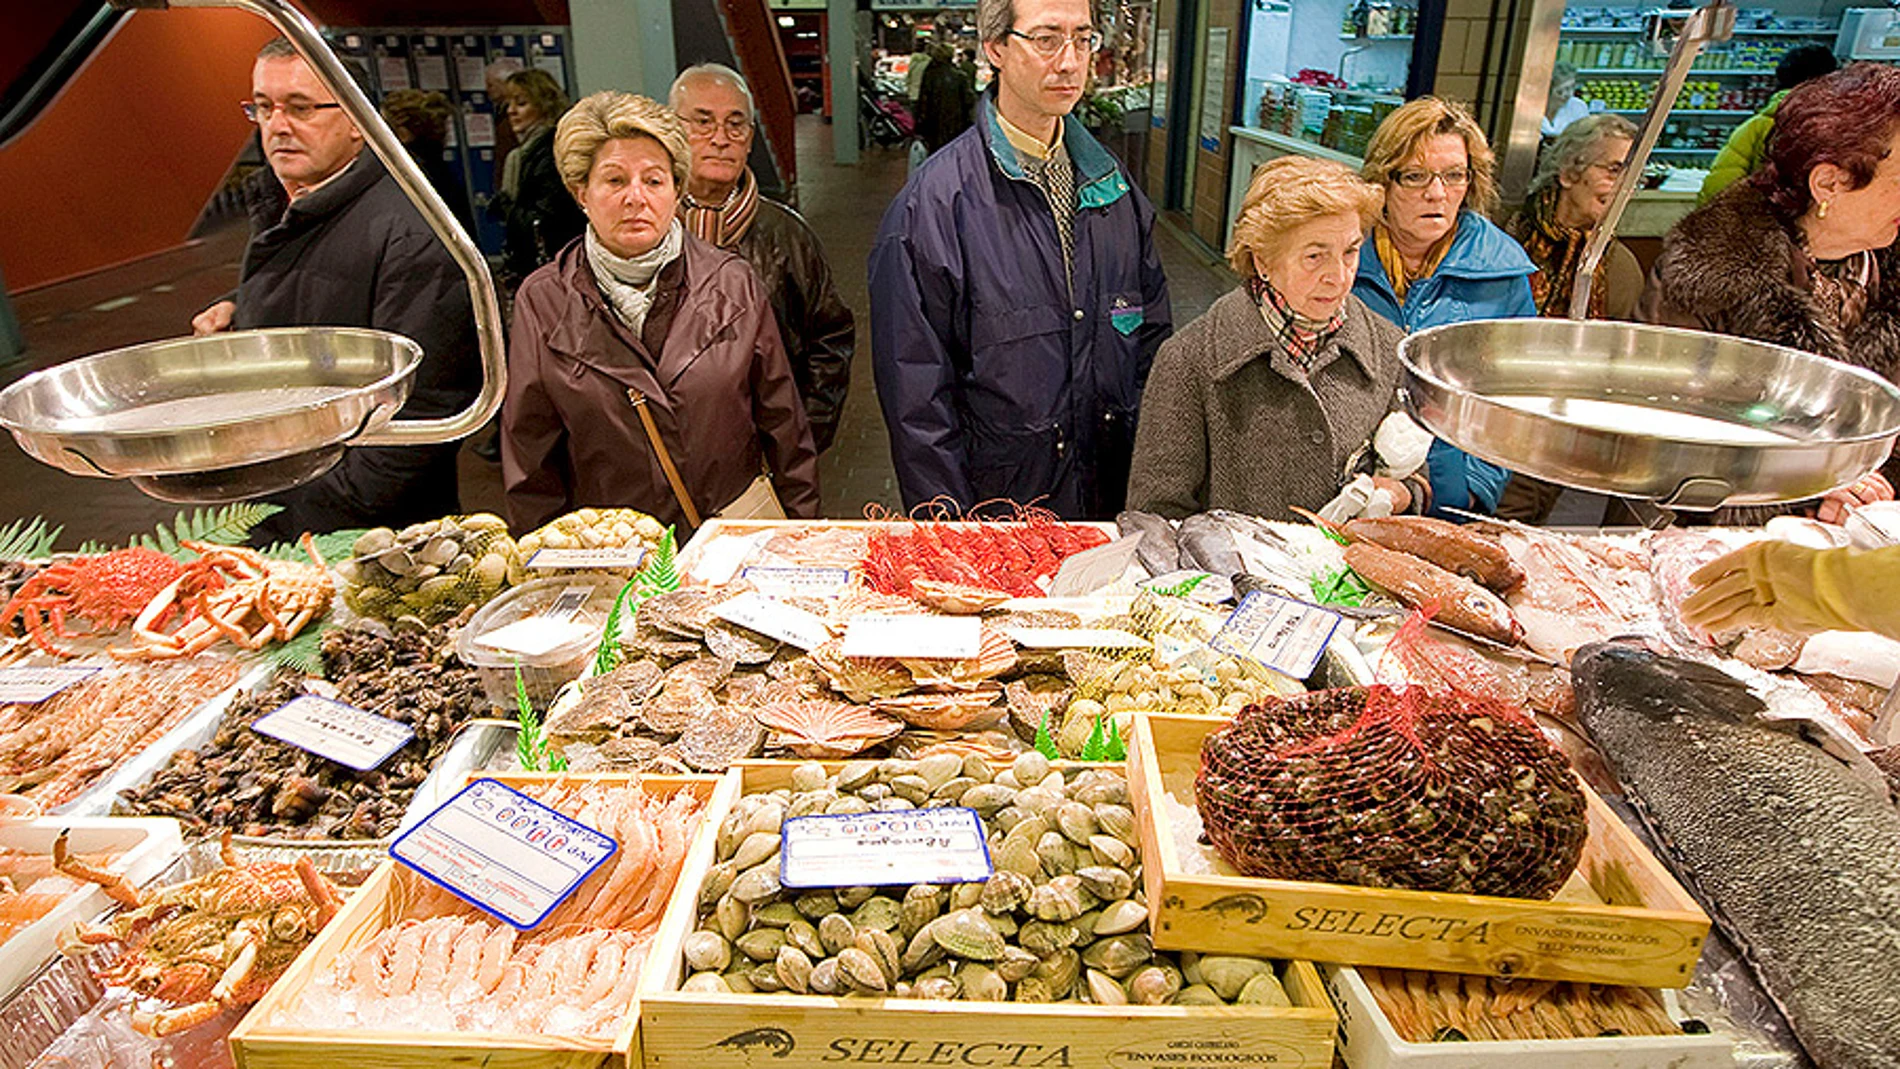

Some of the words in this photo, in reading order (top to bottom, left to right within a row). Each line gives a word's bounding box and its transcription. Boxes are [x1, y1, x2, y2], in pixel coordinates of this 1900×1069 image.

[1285, 906, 1490, 945] SELECTA
[1514, 926, 1573, 939] ENVASES
[821, 1036, 1074, 1068] SELECTA
[1127, 1052, 1188, 1062] ENVASES
